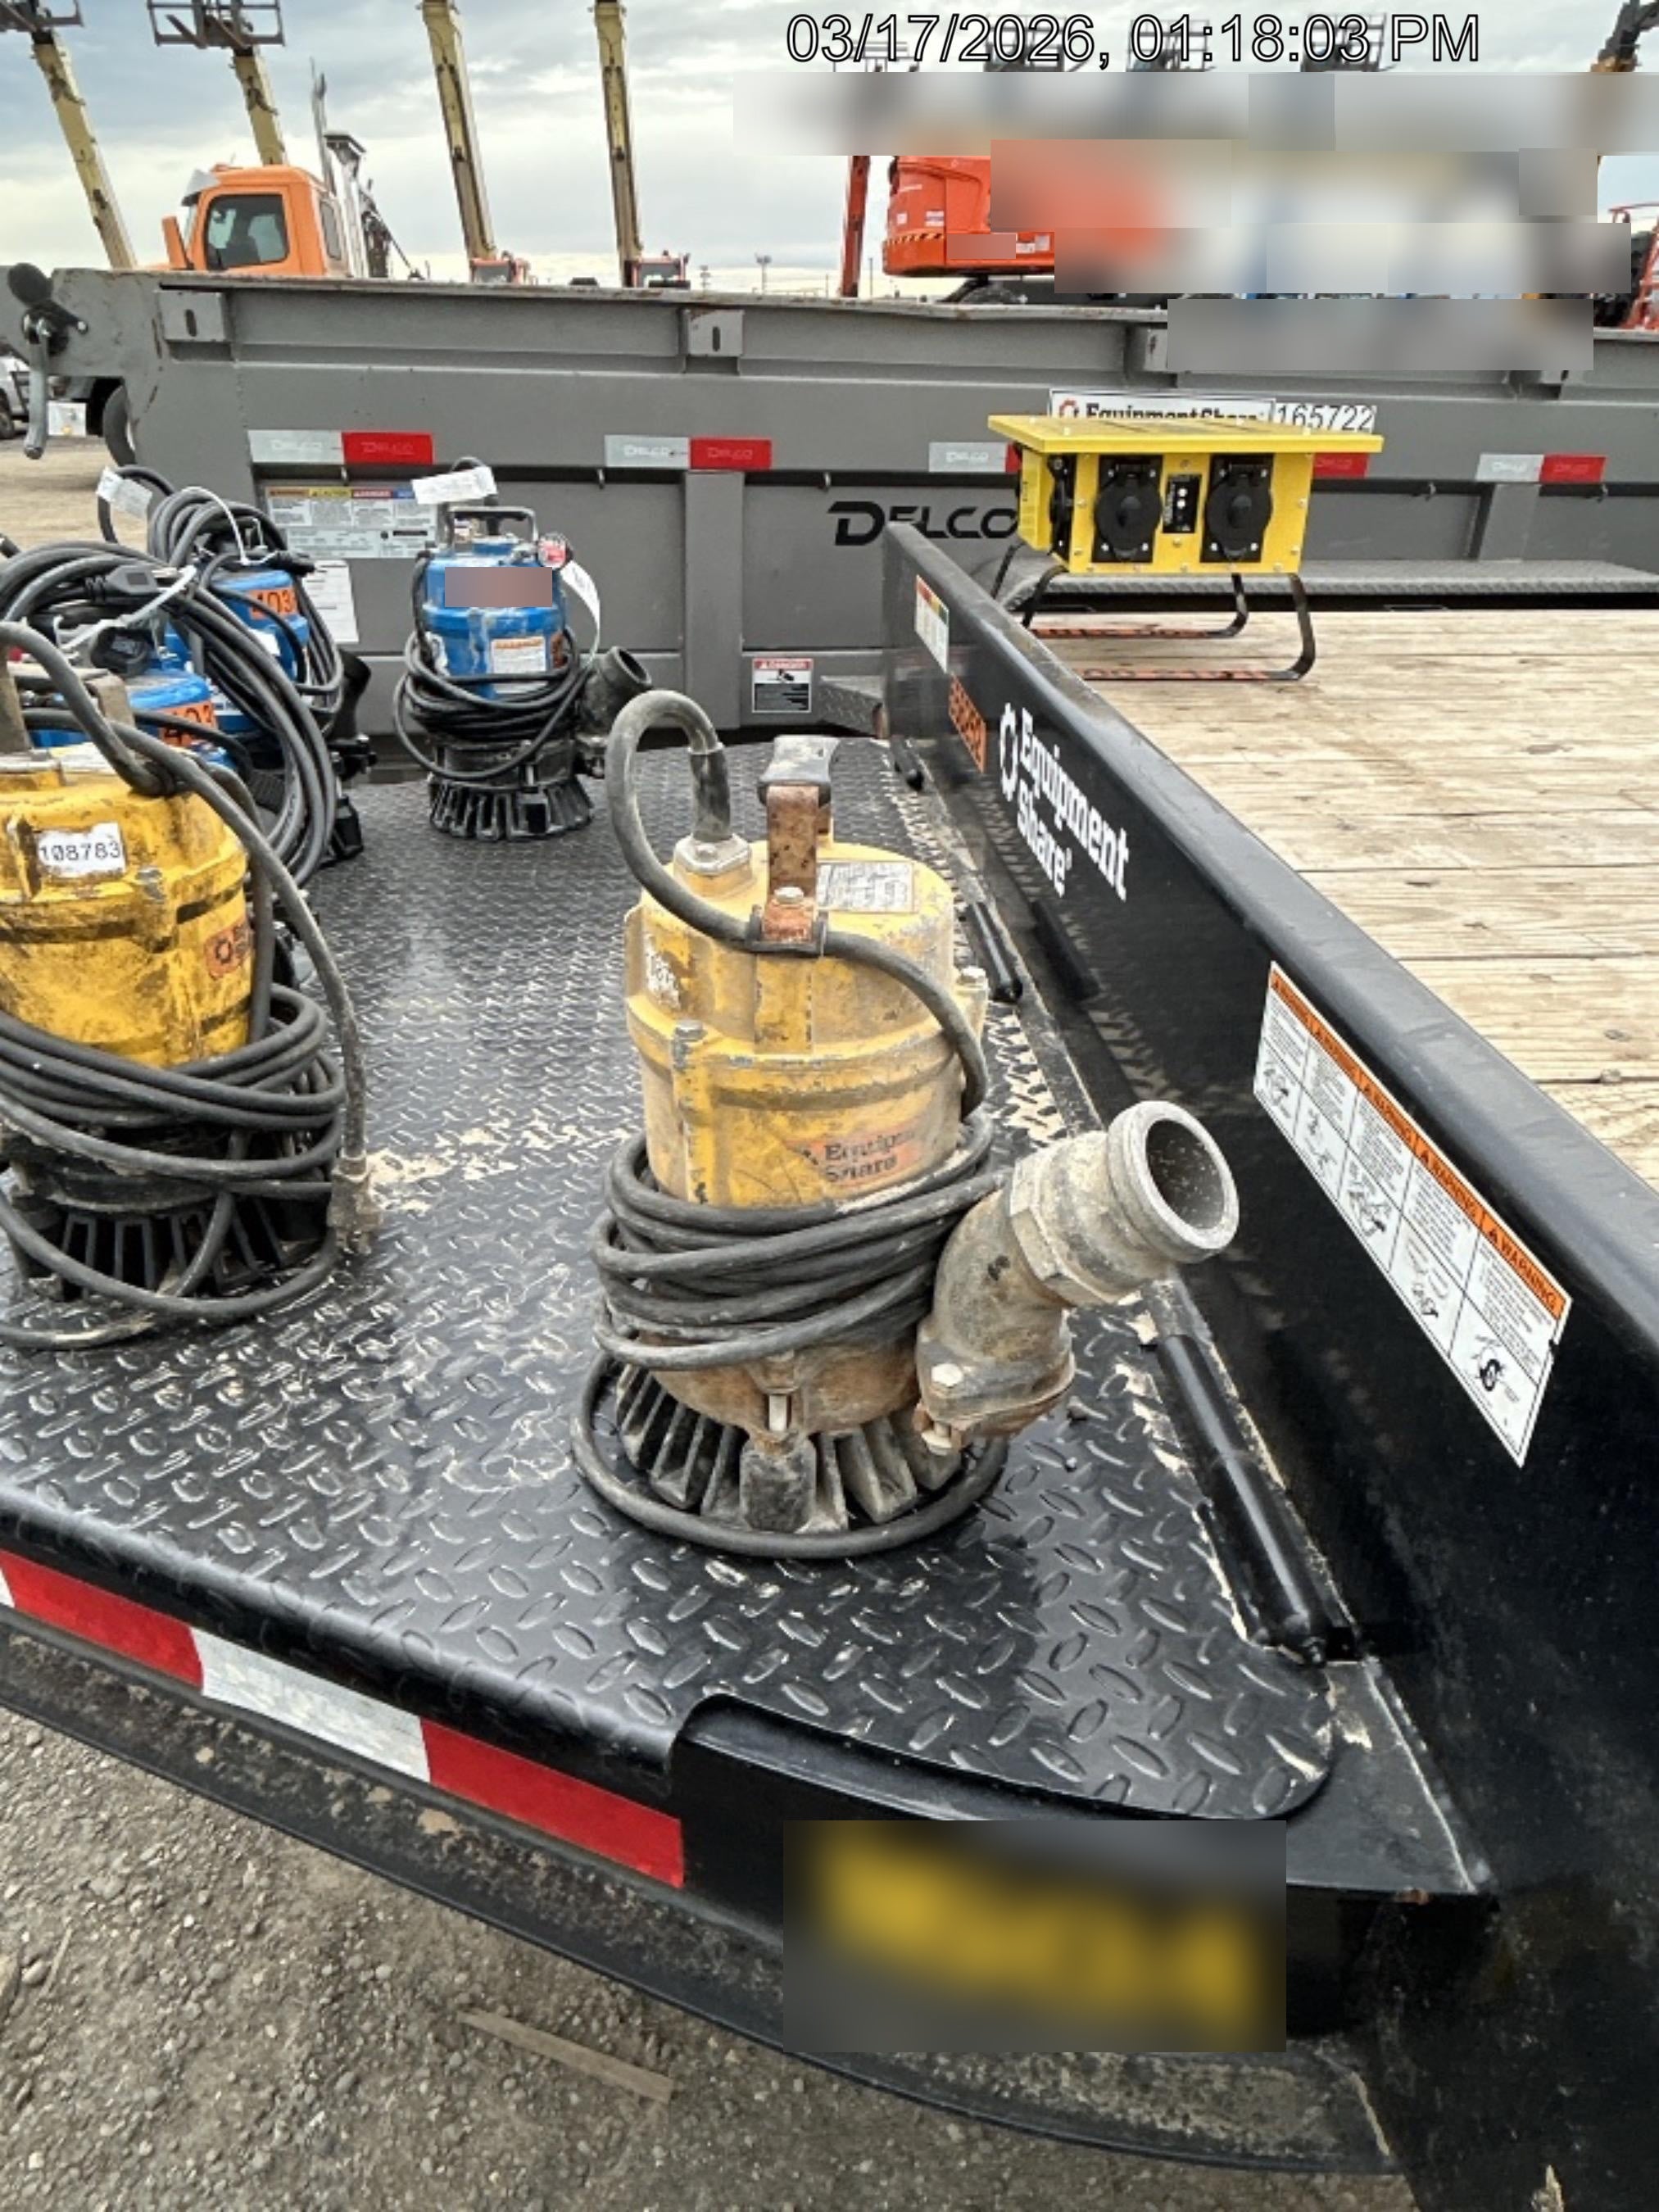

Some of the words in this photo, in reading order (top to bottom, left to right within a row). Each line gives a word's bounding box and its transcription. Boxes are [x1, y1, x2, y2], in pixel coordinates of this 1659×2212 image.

[1278, 402, 1373, 431] 165722
[827, 501, 1018, 546] DELCO
[1020, 707, 1129, 901] Equipment
[39, 841, 121, 861] 108783
[1499, 1235, 1558, 1313] WARNING
